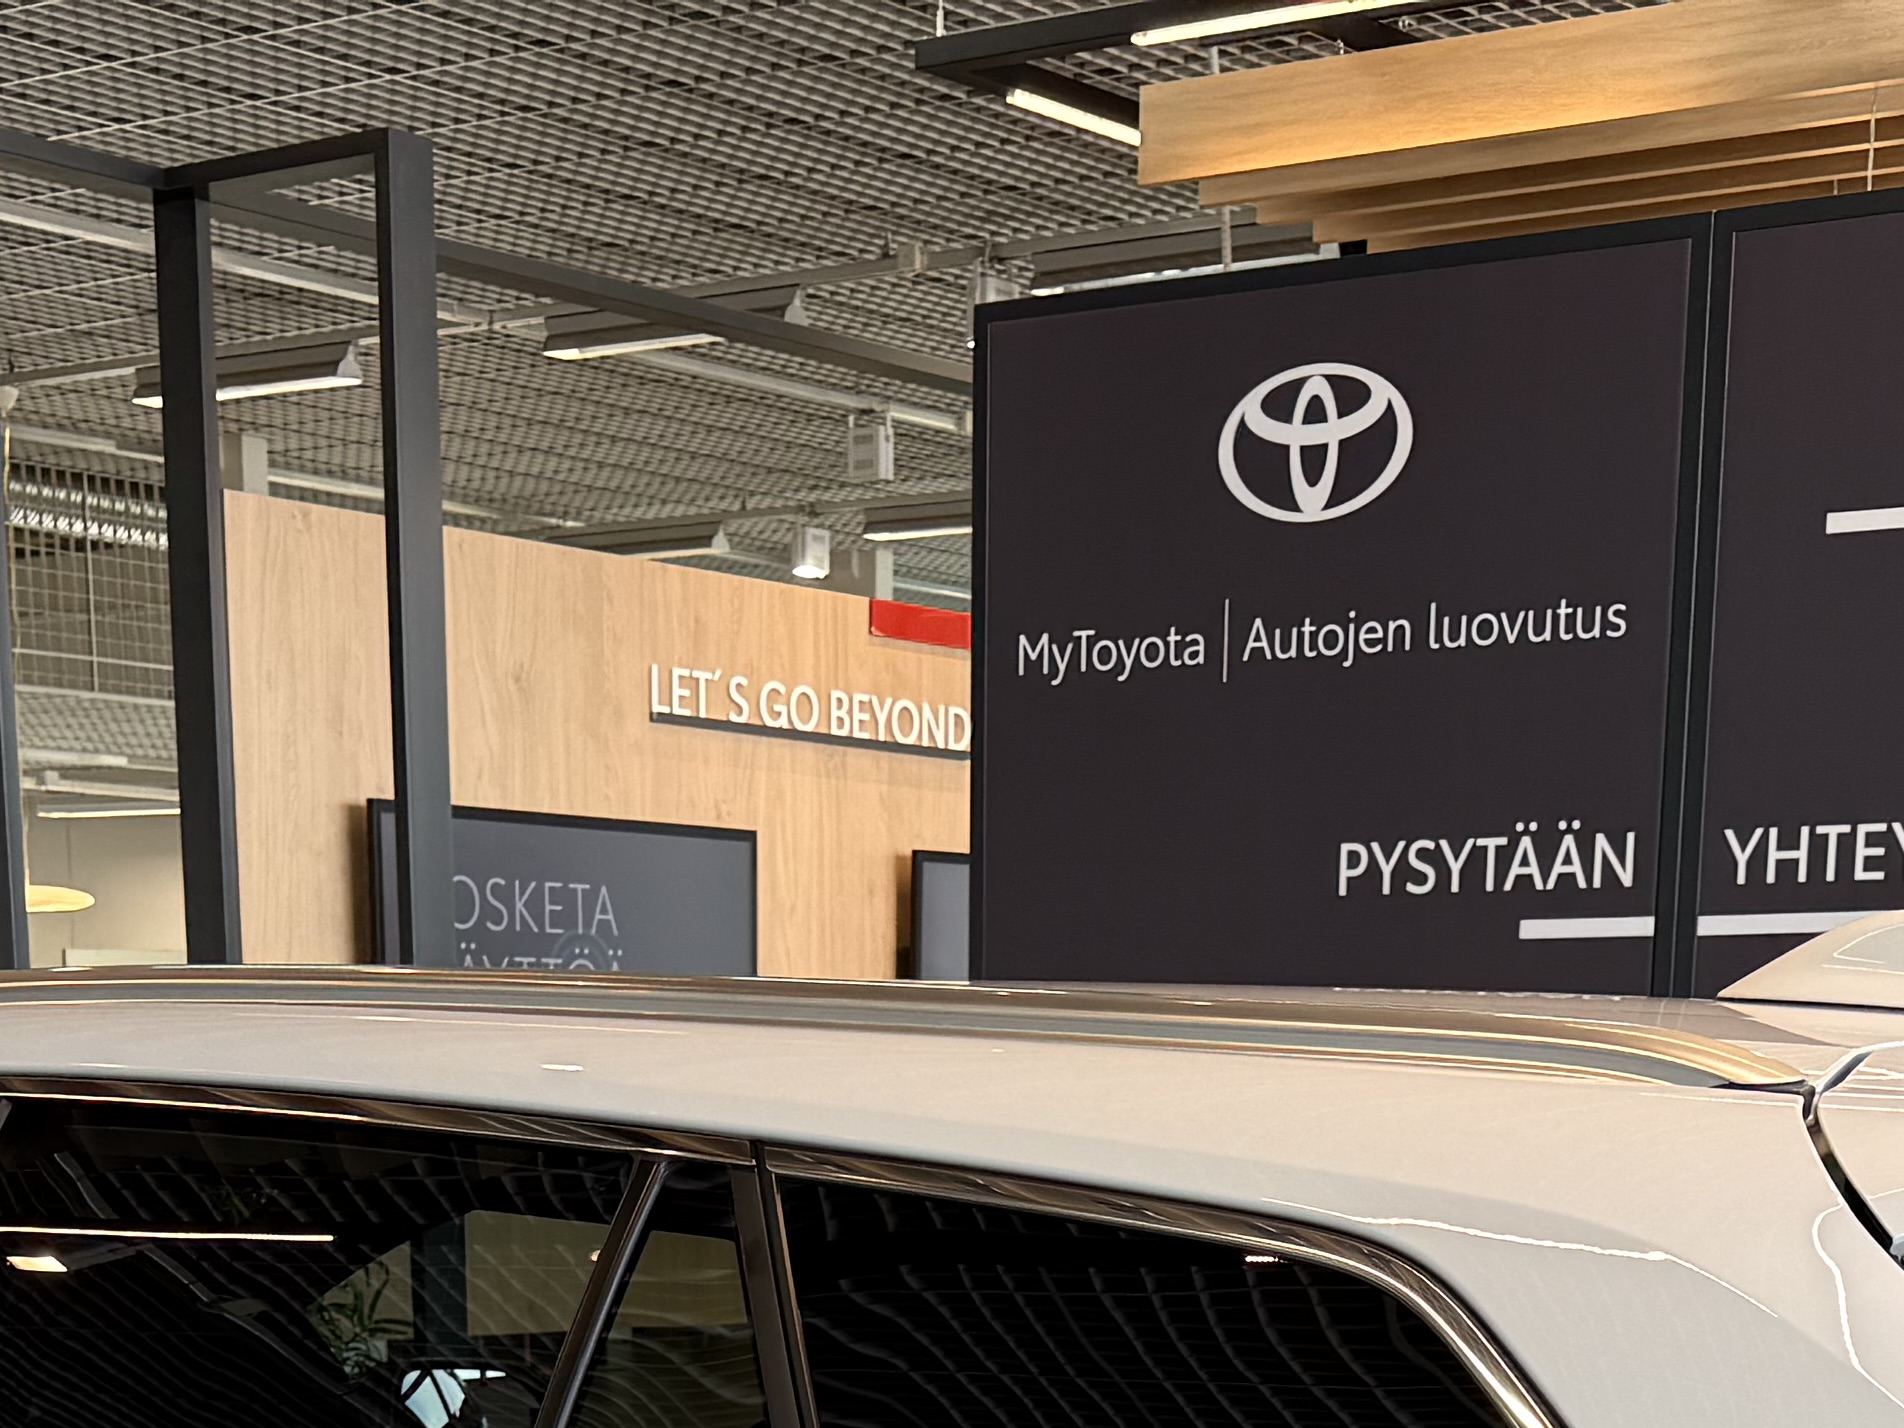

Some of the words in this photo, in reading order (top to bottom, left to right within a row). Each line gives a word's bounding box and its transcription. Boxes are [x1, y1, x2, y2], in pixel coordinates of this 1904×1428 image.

[1016, 626, 1205, 685] MyToyota
[1243, 609, 1411, 667] Autojen
[1428, 597, 1628, 650] luovutus
[759, 680, 819, 732] GO
[830, 689, 971, 752] BEYOND
[1337, 821, 1636, 897] PYSYTÄÄN
[453, 875, 619, 936] OSKETA
